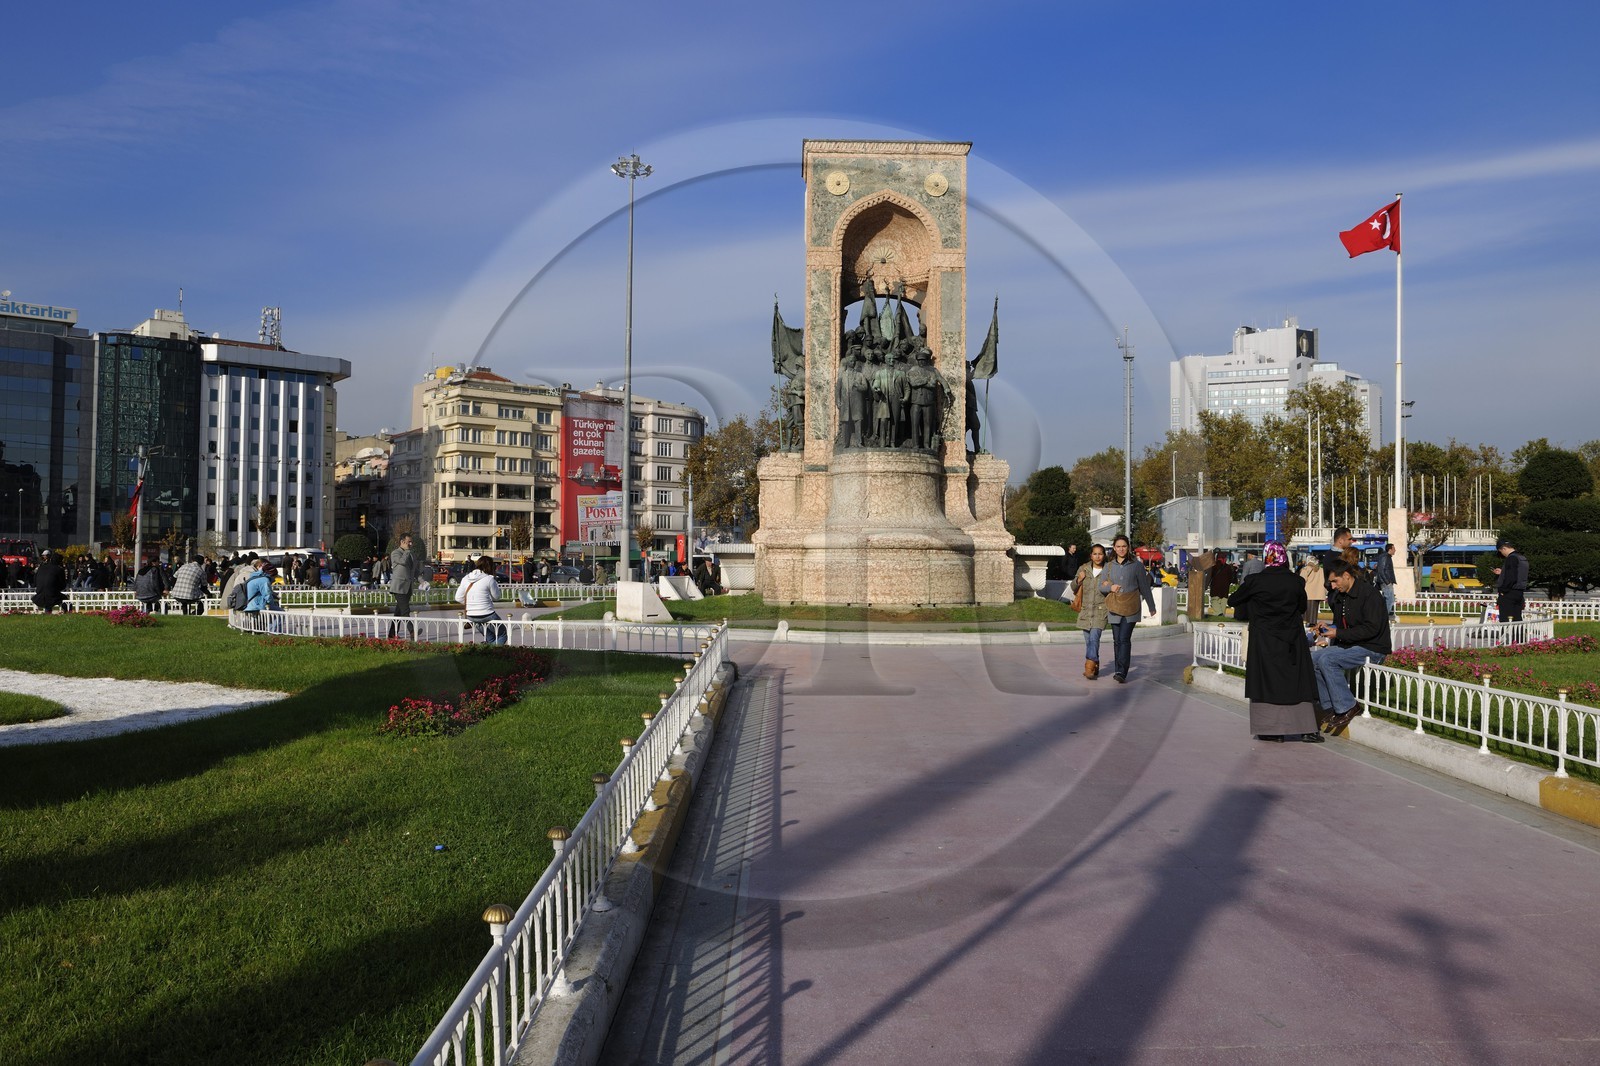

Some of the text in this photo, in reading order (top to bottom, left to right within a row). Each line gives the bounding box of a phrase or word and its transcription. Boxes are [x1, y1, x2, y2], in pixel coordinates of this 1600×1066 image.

[0, 301, 71, 319] aktarlar
[586, 430, 602, 439] çok
[573, 438, 604, 447] okunan
[585, 507, 617, 519] POSTA
